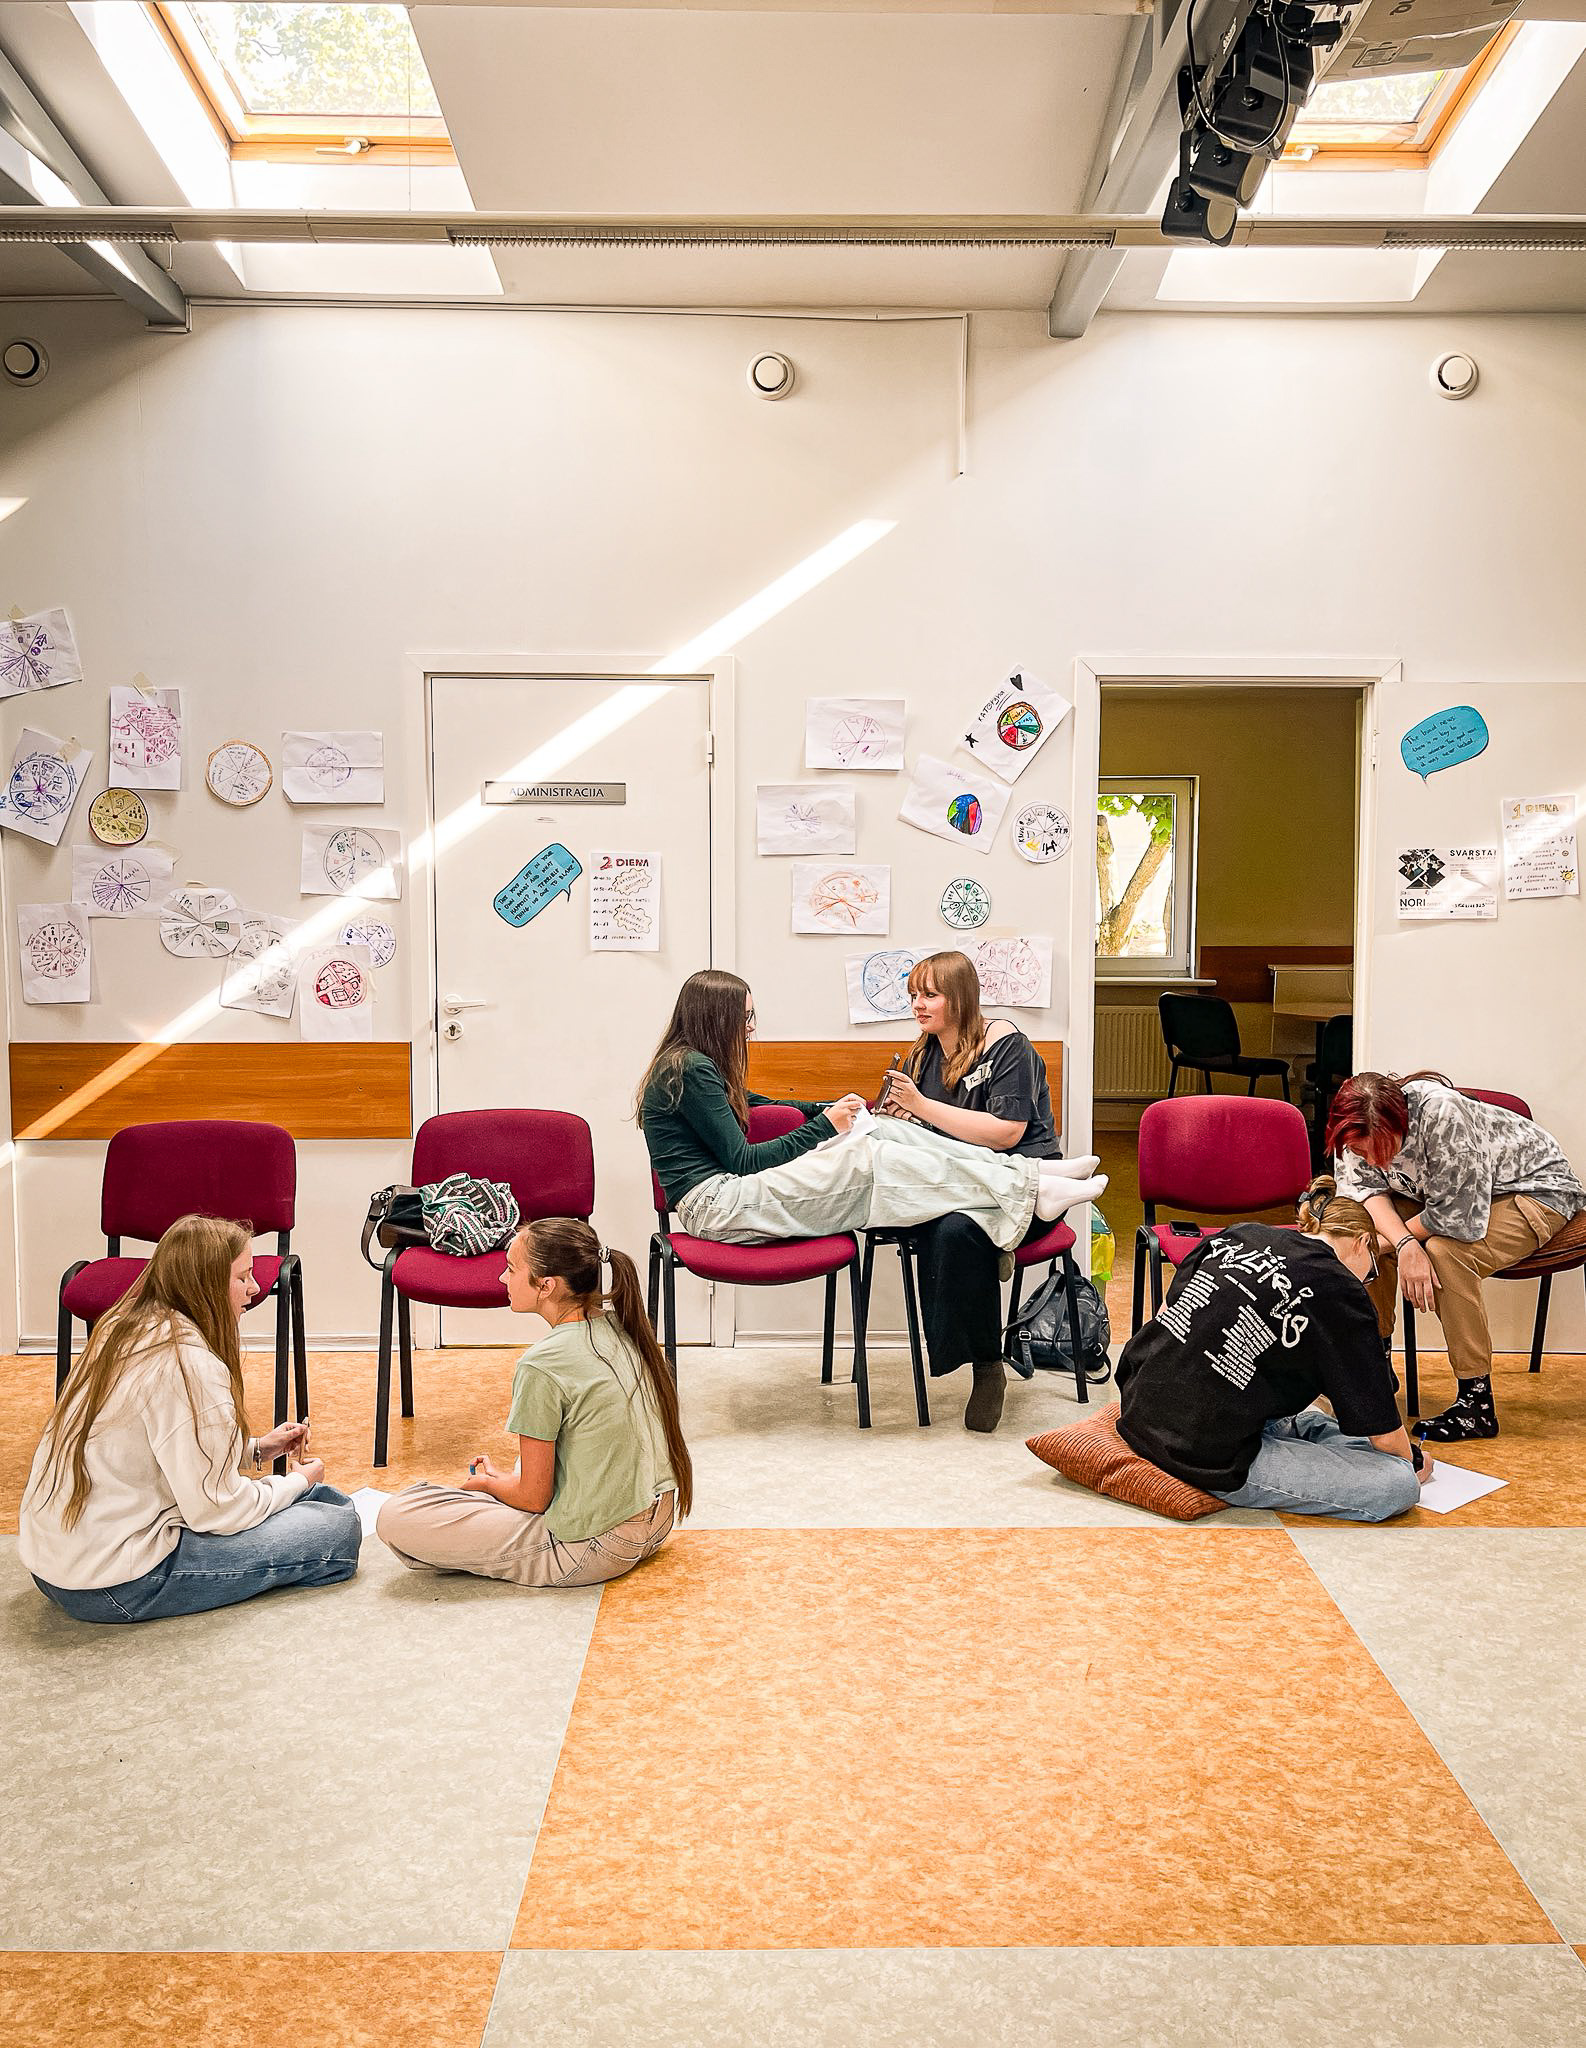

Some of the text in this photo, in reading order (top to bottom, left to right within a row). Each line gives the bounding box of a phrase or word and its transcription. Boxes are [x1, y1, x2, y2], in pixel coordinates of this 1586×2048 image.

[510, 787, 604, 797] ADMINISTRACIJA
[1525, 803, 1559, 813] DIENA
[616, 858, 649, 867] DIENA
[530, 874, 540, 883] AND
[538, 868, 559, 888] TERRIBLE
[1400, 898, 1426, 907] NORI
